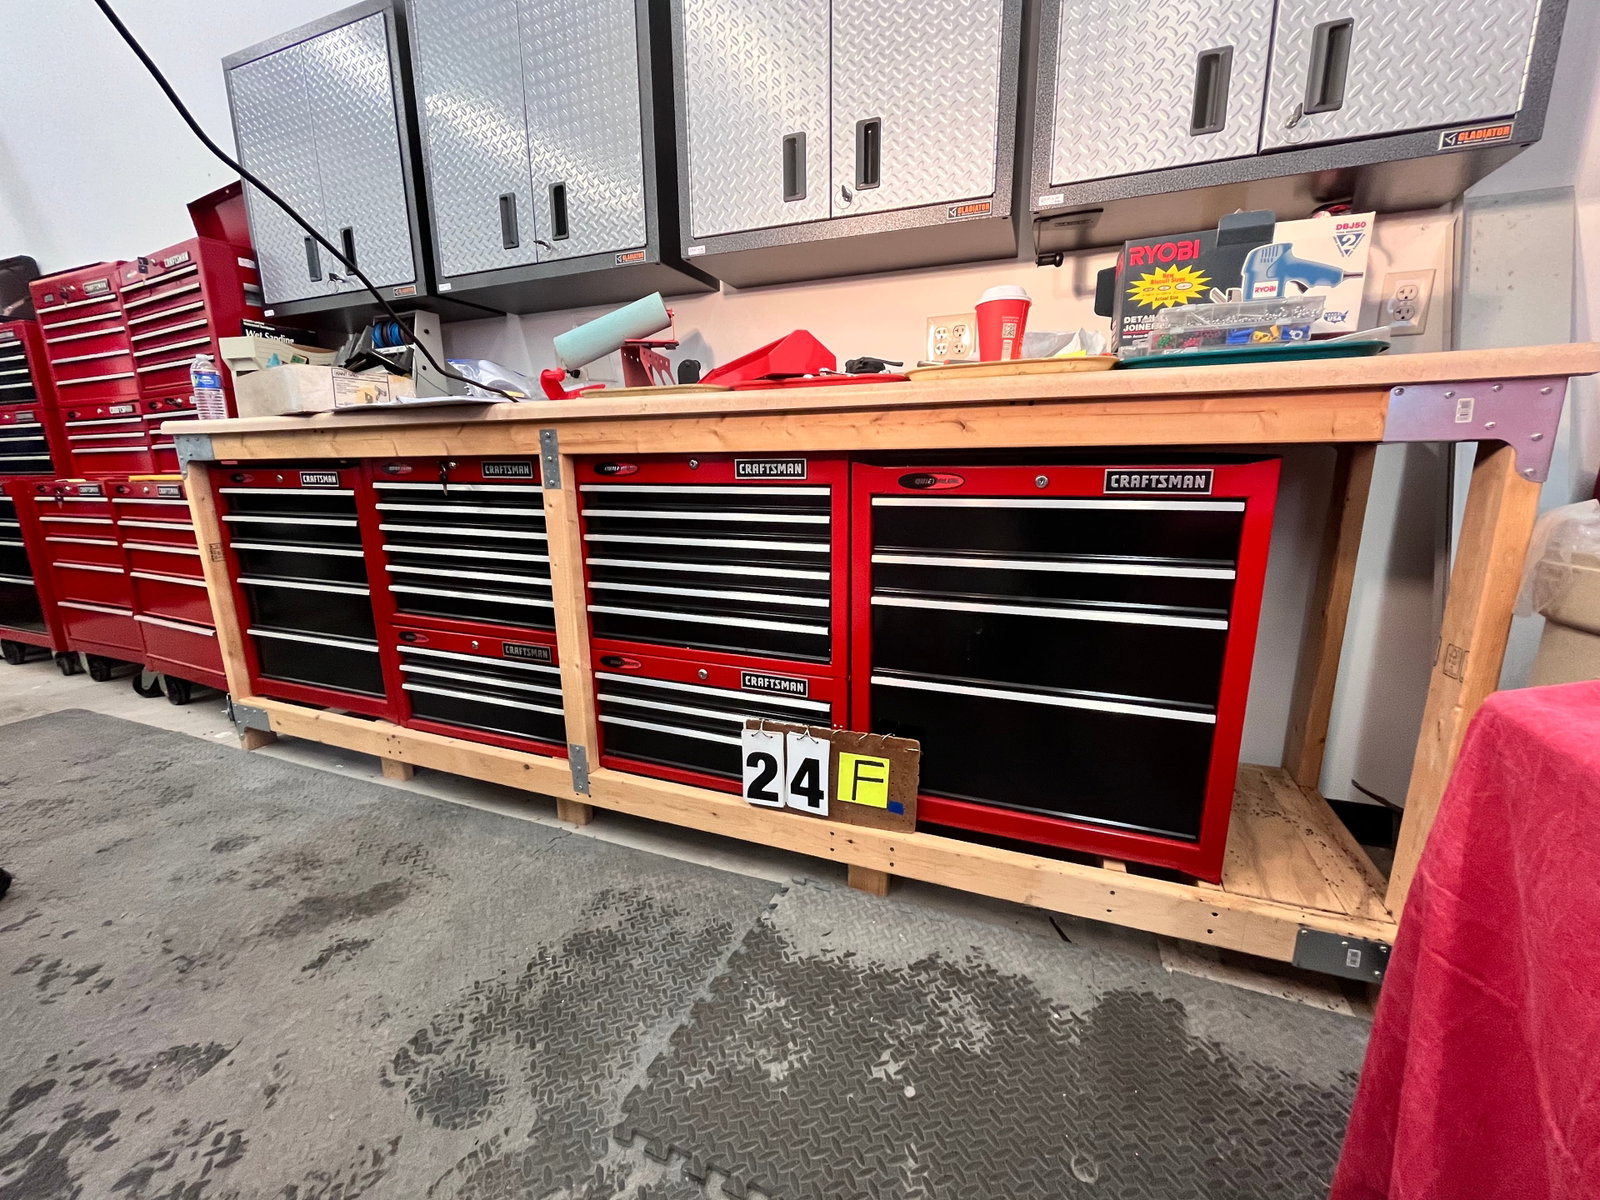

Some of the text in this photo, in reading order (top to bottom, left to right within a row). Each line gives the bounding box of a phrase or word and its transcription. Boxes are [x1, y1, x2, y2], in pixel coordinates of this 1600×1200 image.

[1457, 125, 1511, 141] GLADIATOR
[957, 202, 990, 214] GLADIATOR
[1335, 221, 1367, 231] DBJ50
[1341, 234, 1356, 247] 2
[1128, 239, 1200, 266] RYOBI
[1254, 285, 1277, 293] RYOBI
[245, 329, 263, 338] Wet
[484, 464, 530, 474] CRAFTSMAN
[739, 463, 802, 475] CRAFTSMAN
[302, 475, 336, 483] CRAFTSMAN
[1110, 474, 1207, 489] CRAFTSMAN
[505, 645, 548, 659] CRAFTSMAN
[745, 676, 804, 693] CRAFTSMAN
[746, 752, 824, 808] 24
[852, 759, 884, 801] F
